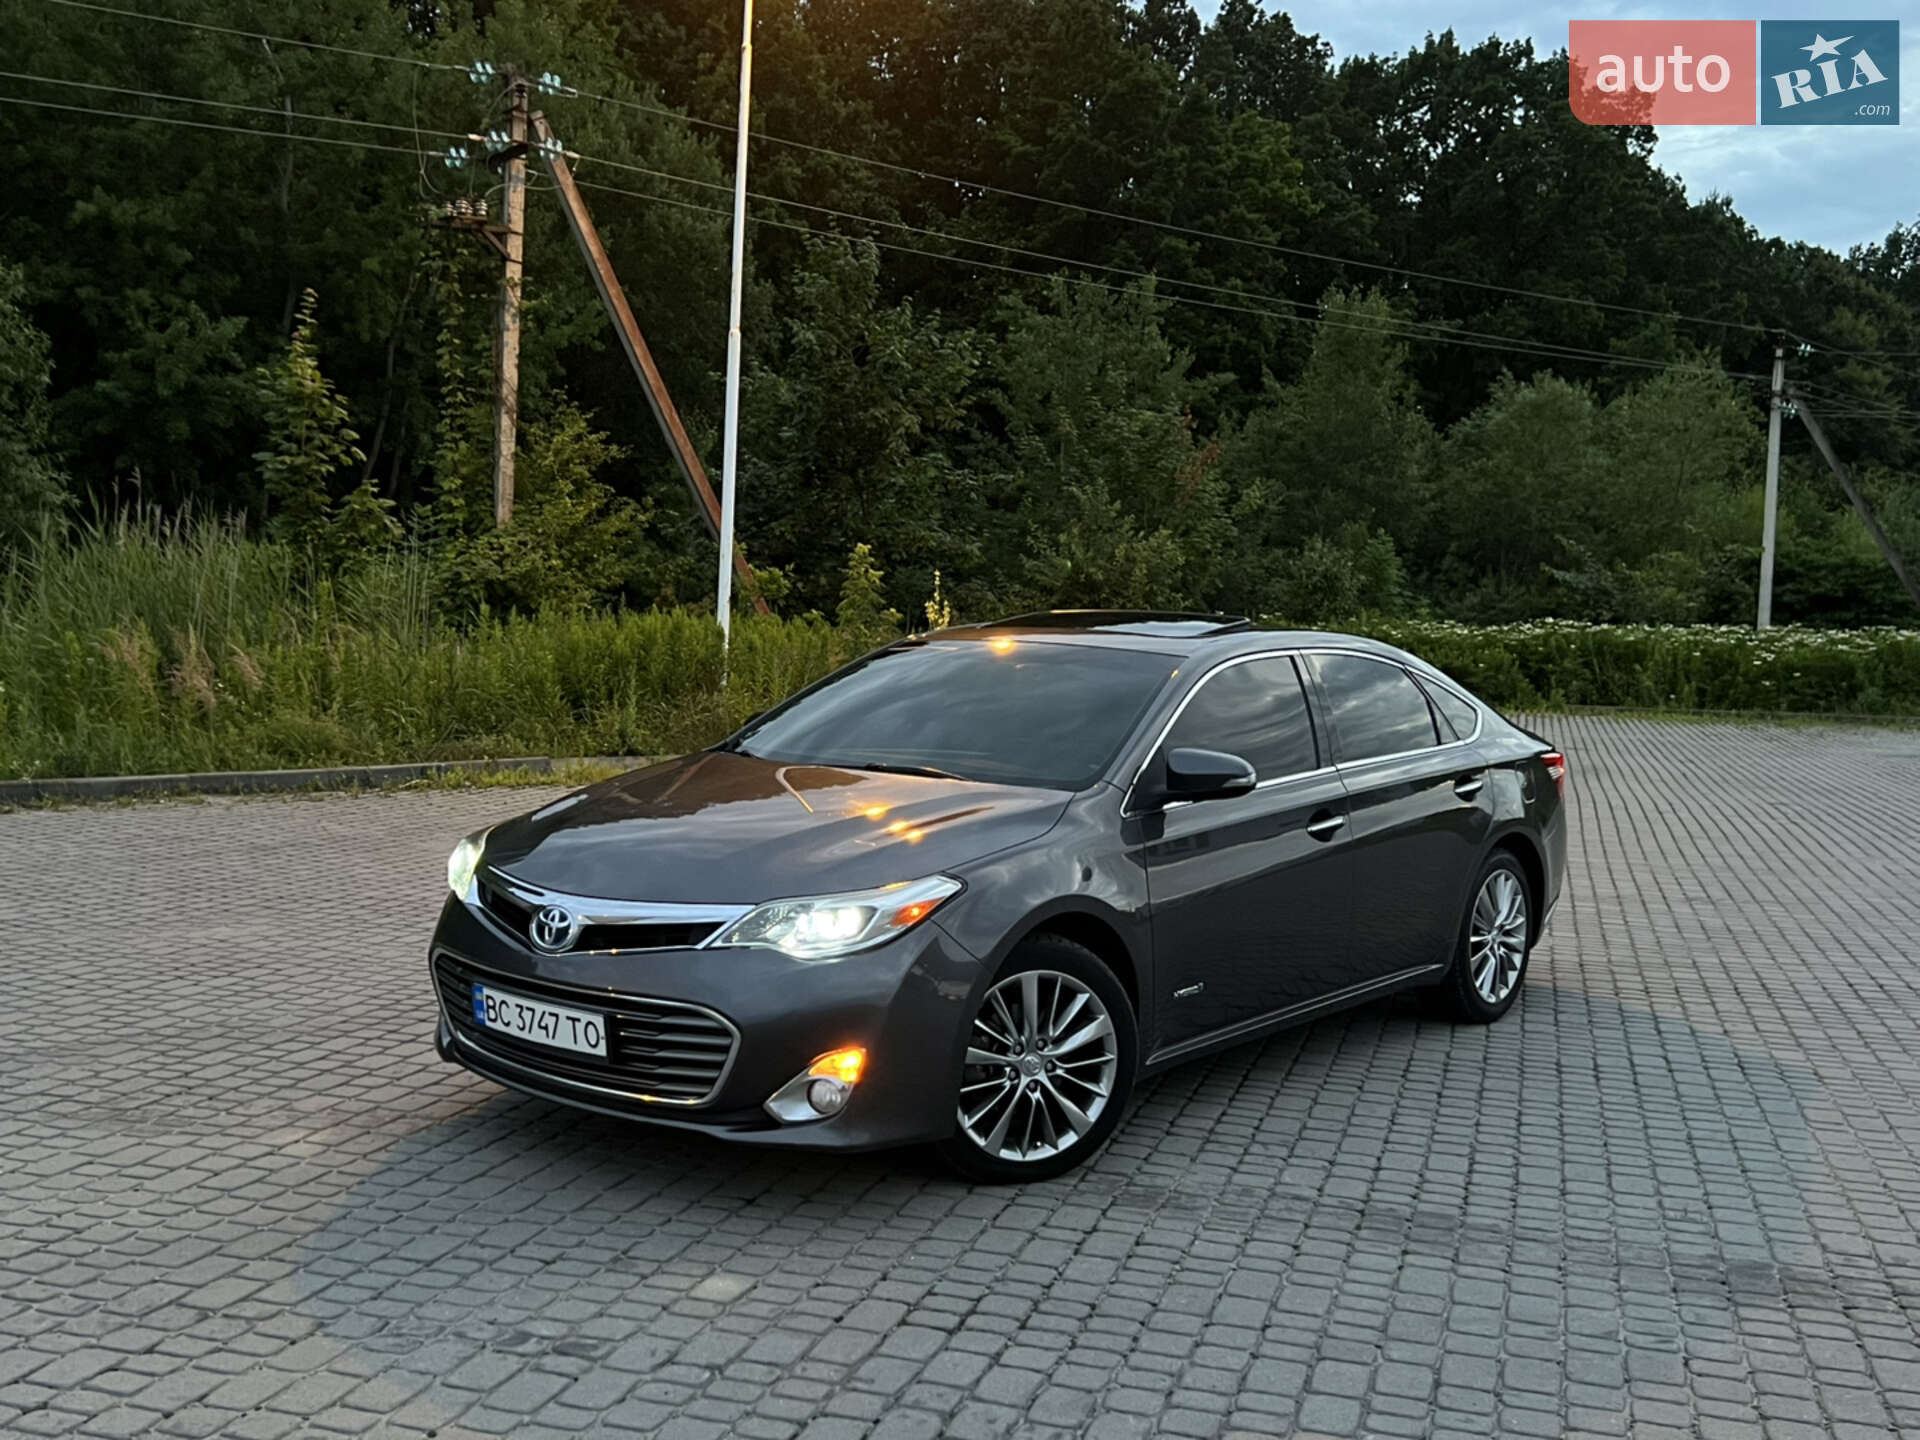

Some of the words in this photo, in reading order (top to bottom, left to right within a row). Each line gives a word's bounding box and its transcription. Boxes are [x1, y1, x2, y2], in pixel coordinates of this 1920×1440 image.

[485, 995, 511, 1027] BC
[515, 1003, 559, 1040] 3747
[566, 1016, 600, 1049] TO
